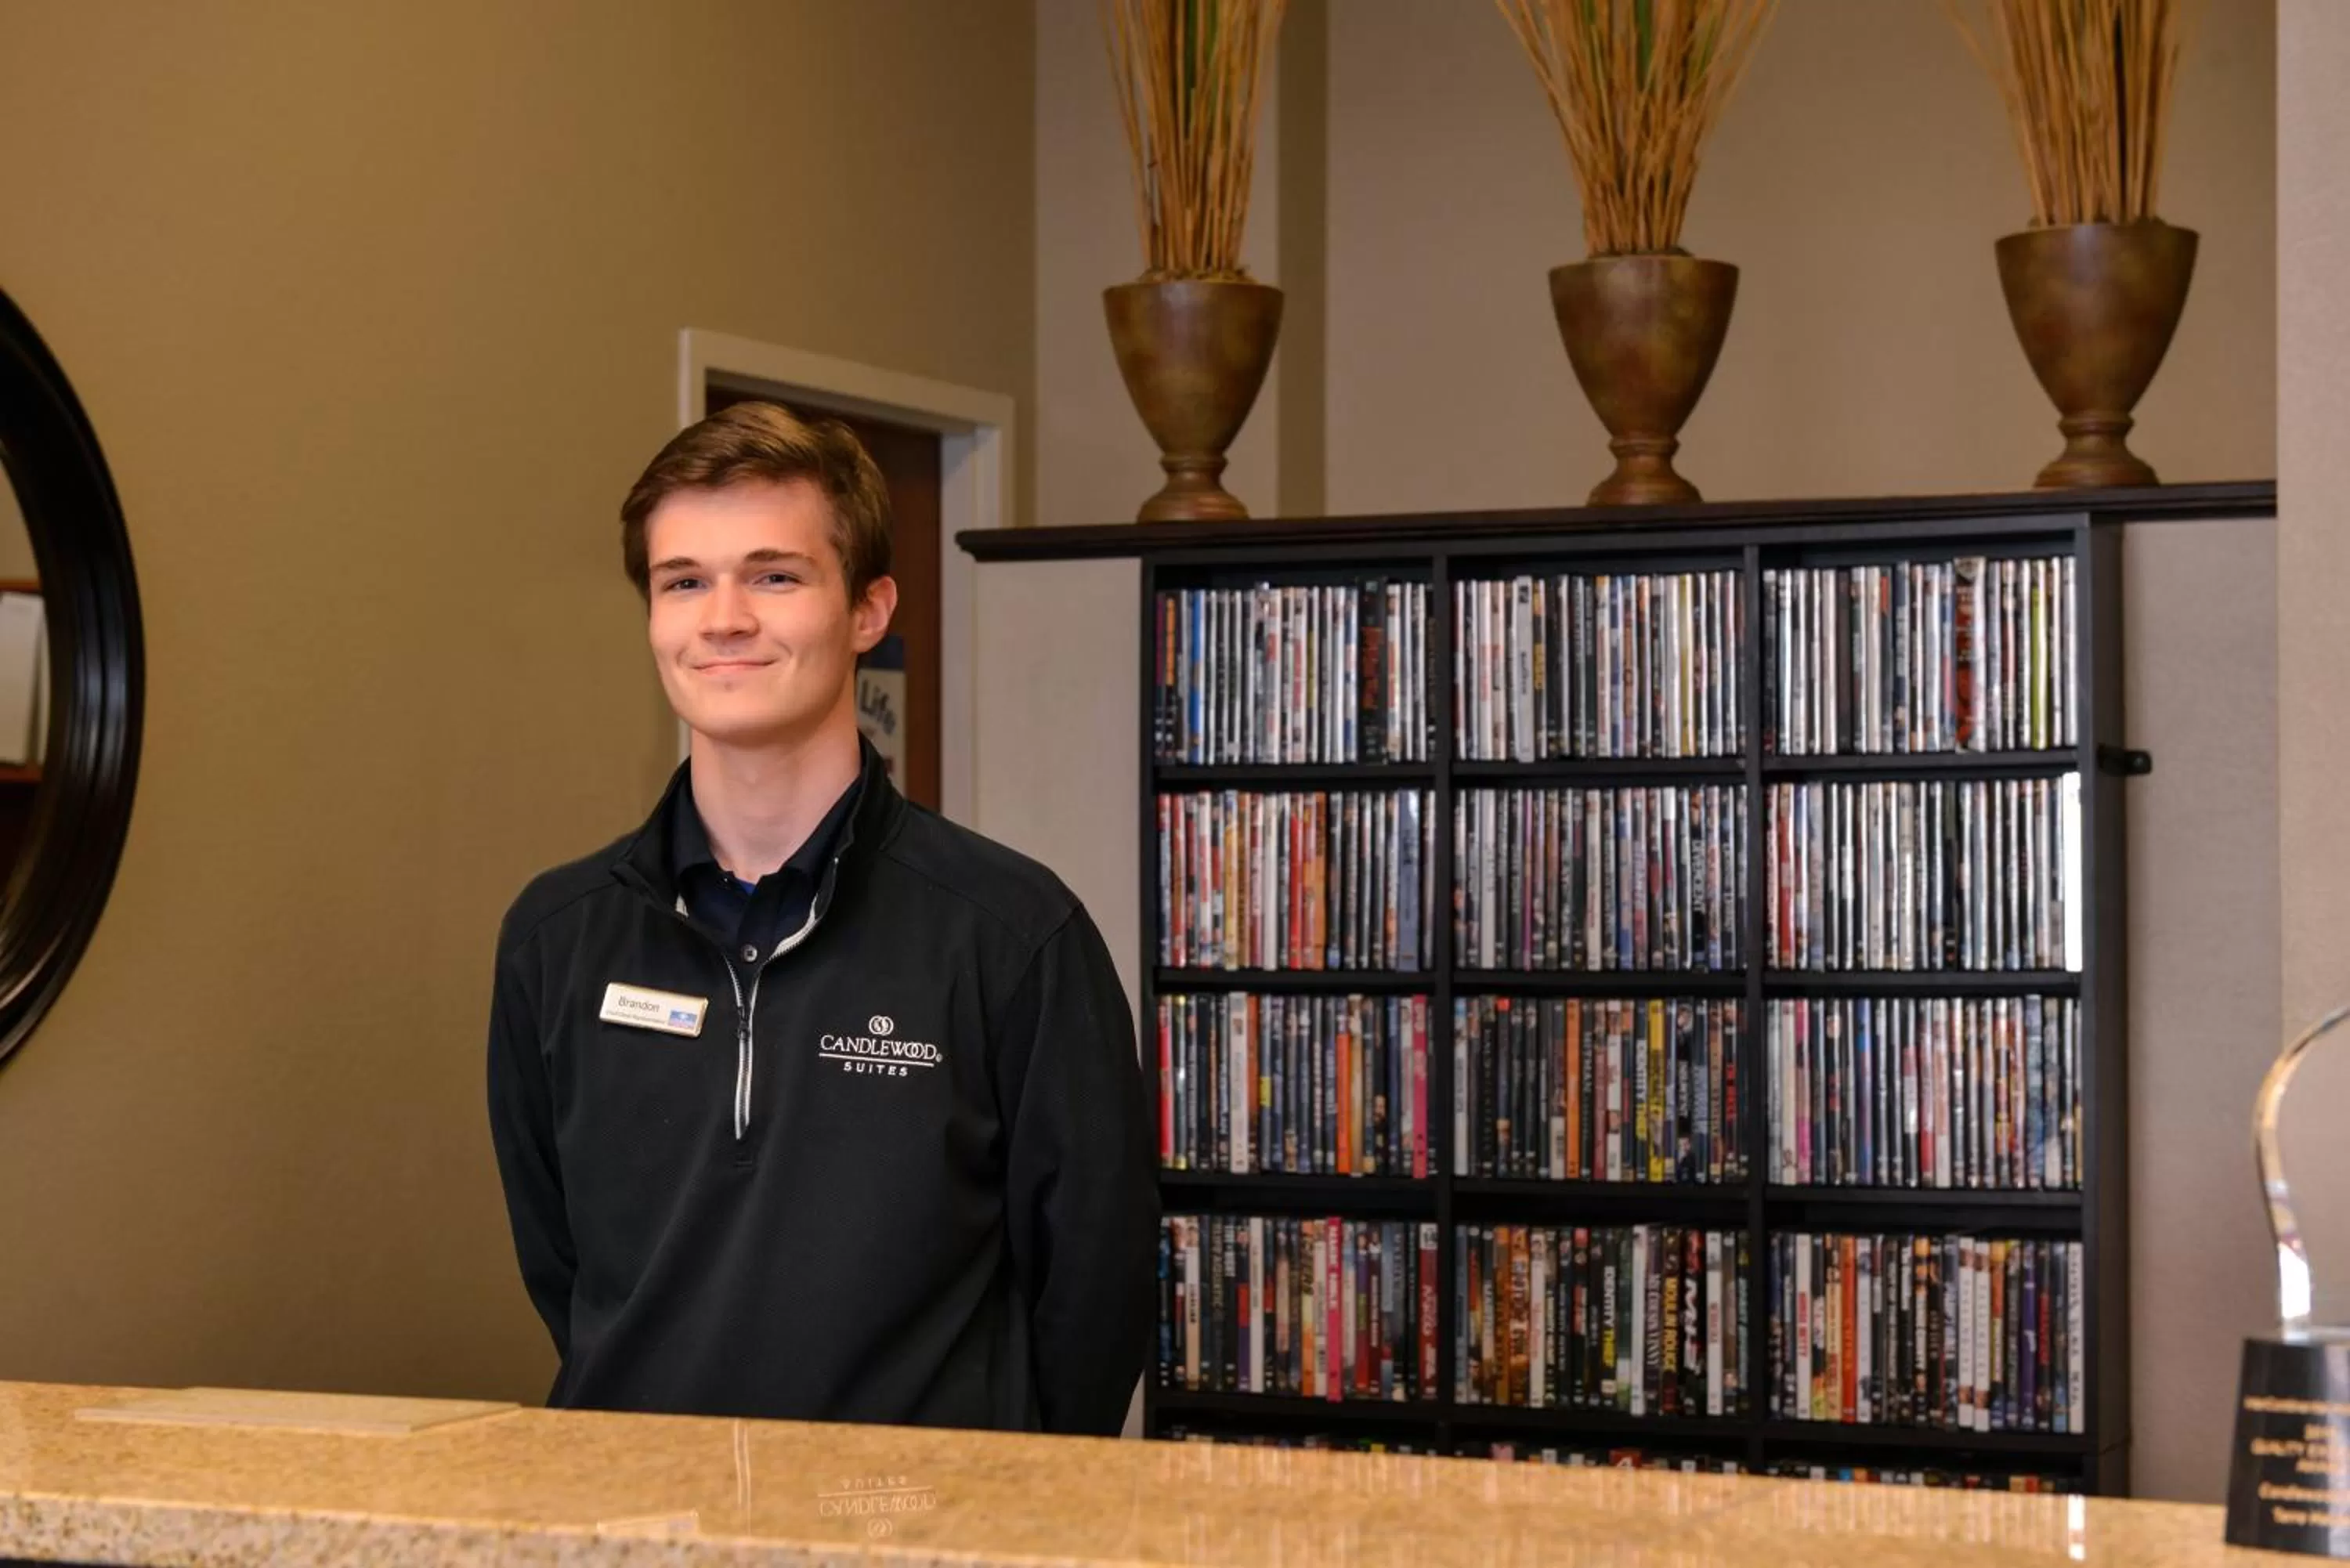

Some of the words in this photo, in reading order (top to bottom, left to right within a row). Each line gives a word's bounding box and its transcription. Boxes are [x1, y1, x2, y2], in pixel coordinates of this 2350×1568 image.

[618, 995, 660, 1013] Brandon
[820, 1035, 937, 1060] CANDLEWOOD
[843, 1061, 908, 1077] SUITES
[1603, 1265, 1616, 1327] IDENTITY
[1664, 1276, 1679, 1328] MOULIN
[1603, 1328, 1616, 1367] THIEF
[1662, 1328, 1679, 1373] ROUGE
